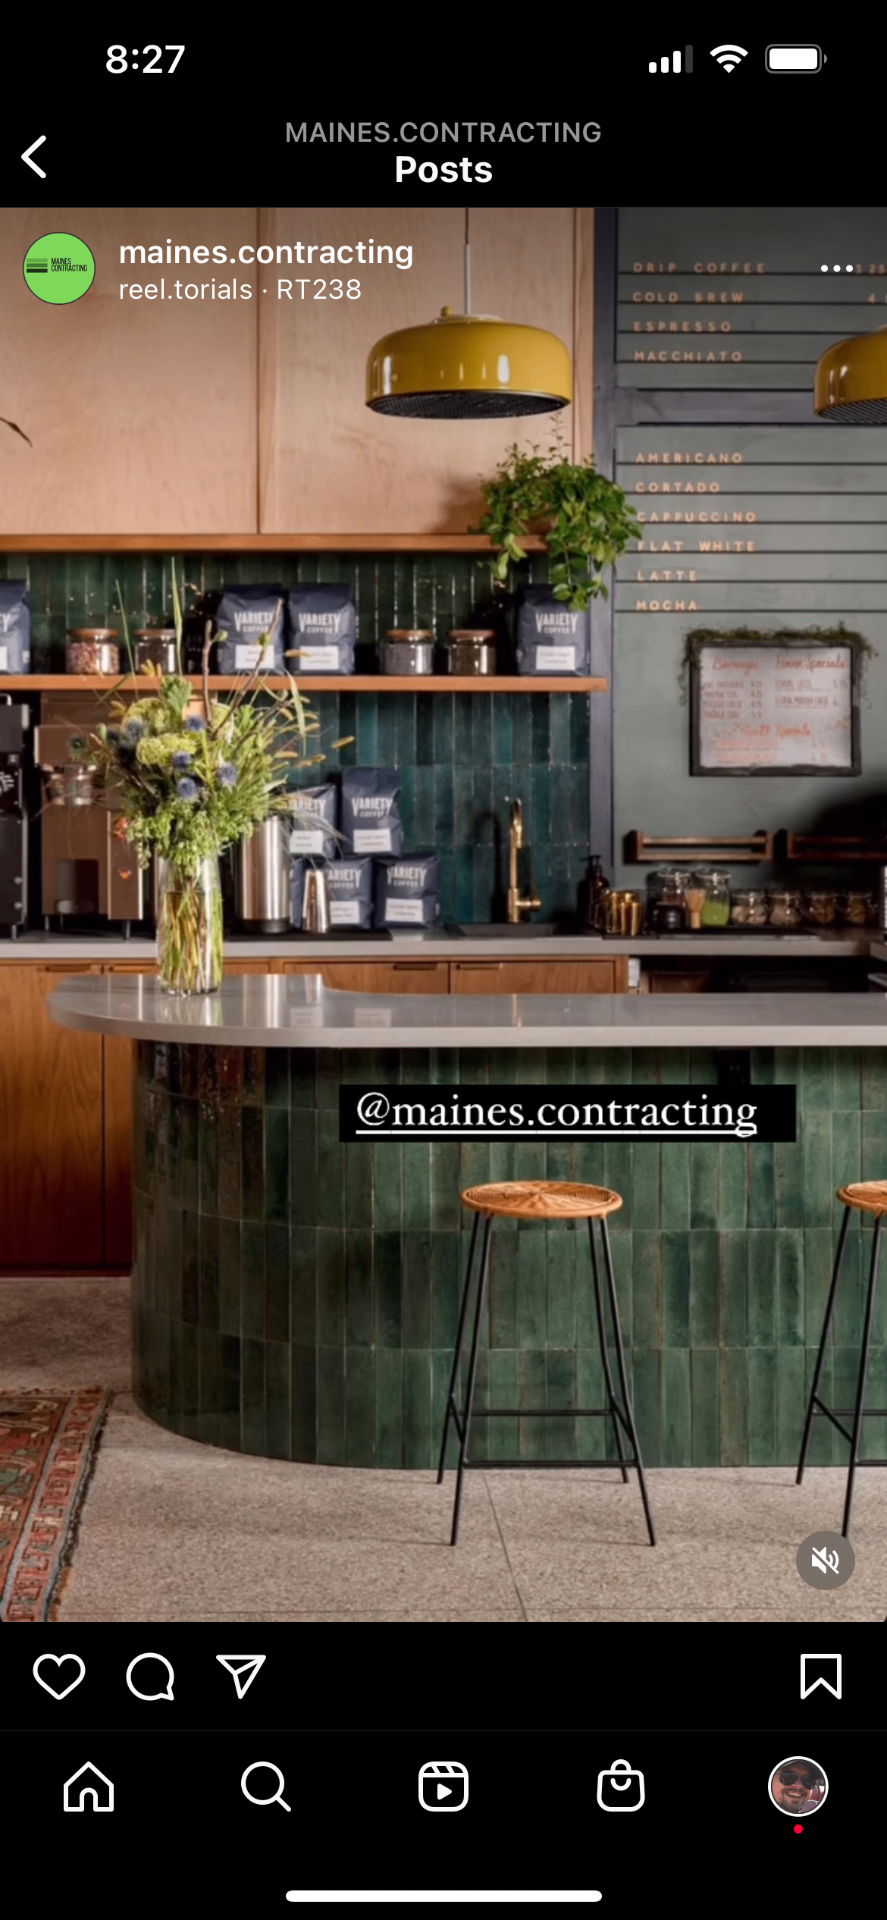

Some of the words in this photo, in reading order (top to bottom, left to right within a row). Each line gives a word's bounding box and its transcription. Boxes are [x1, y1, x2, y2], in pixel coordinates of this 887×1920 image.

[633, 262, 677, 274] DRIP
[693, 262, 766, 274] COFFEE
[632, 292, 679, 303] COLD
[694, 292, 744, 303] BREW
[633, 321, 731, 332] ESPRESSO
[634, 351, 743, 362] MACCHIATO
[635, 452, 744, 464] AMERICANO
[635, 482, 721, 493] CORTADO
[636, 511, 757, 523] CAPPUCCINO
[637, 540, 684, 552] FLAT
[698, 540, 755, 552] WHITE
[636, 570, 697, 581] LATTE
[635, 600, 698, 611] MOCHA
[298, 613, 341, 633] VARIETY
[535, 612, 579, 633] VARIETY
[351, 797, 393, 817] VARIETY
[387, 867, 427, 887] VARIETY
